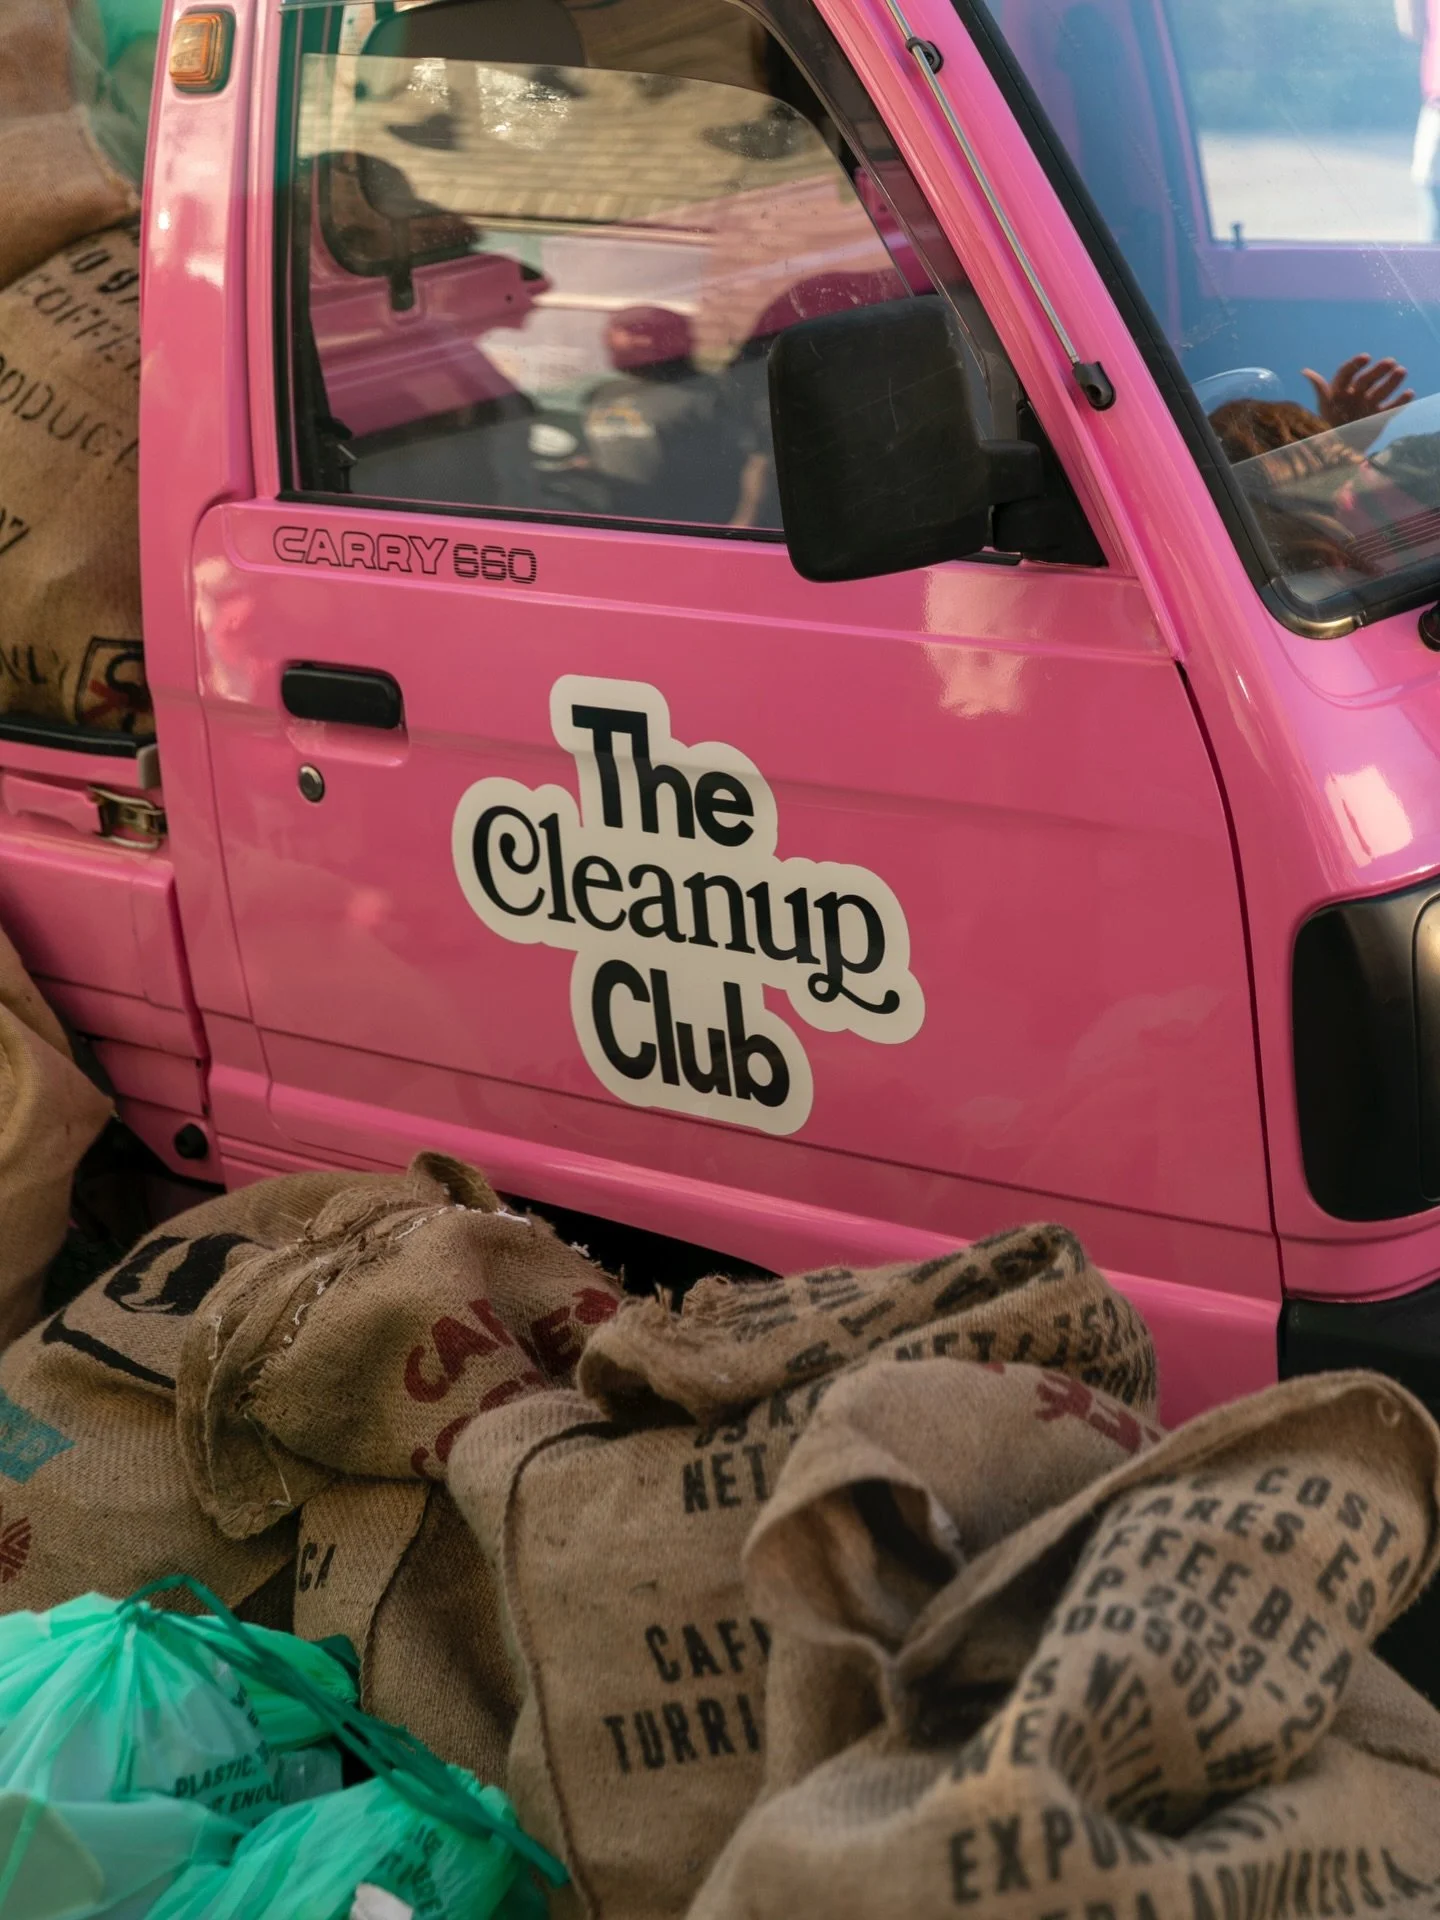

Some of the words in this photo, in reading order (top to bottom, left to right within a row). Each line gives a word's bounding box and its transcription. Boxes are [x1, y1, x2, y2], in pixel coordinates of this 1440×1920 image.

[273, 526, 448, 575] CARRY
[453, 543, 537, 585] 660
[571, 703, 755, 848] The
[472, 804, 901, 1015] Cleanup
[591, 958, 790, 1108] Club
[682, 1443, 769, 1514] NET
[602, 1692, 761, 1774] TURRI
[950, 1804, 1177, 1907] EXPO
